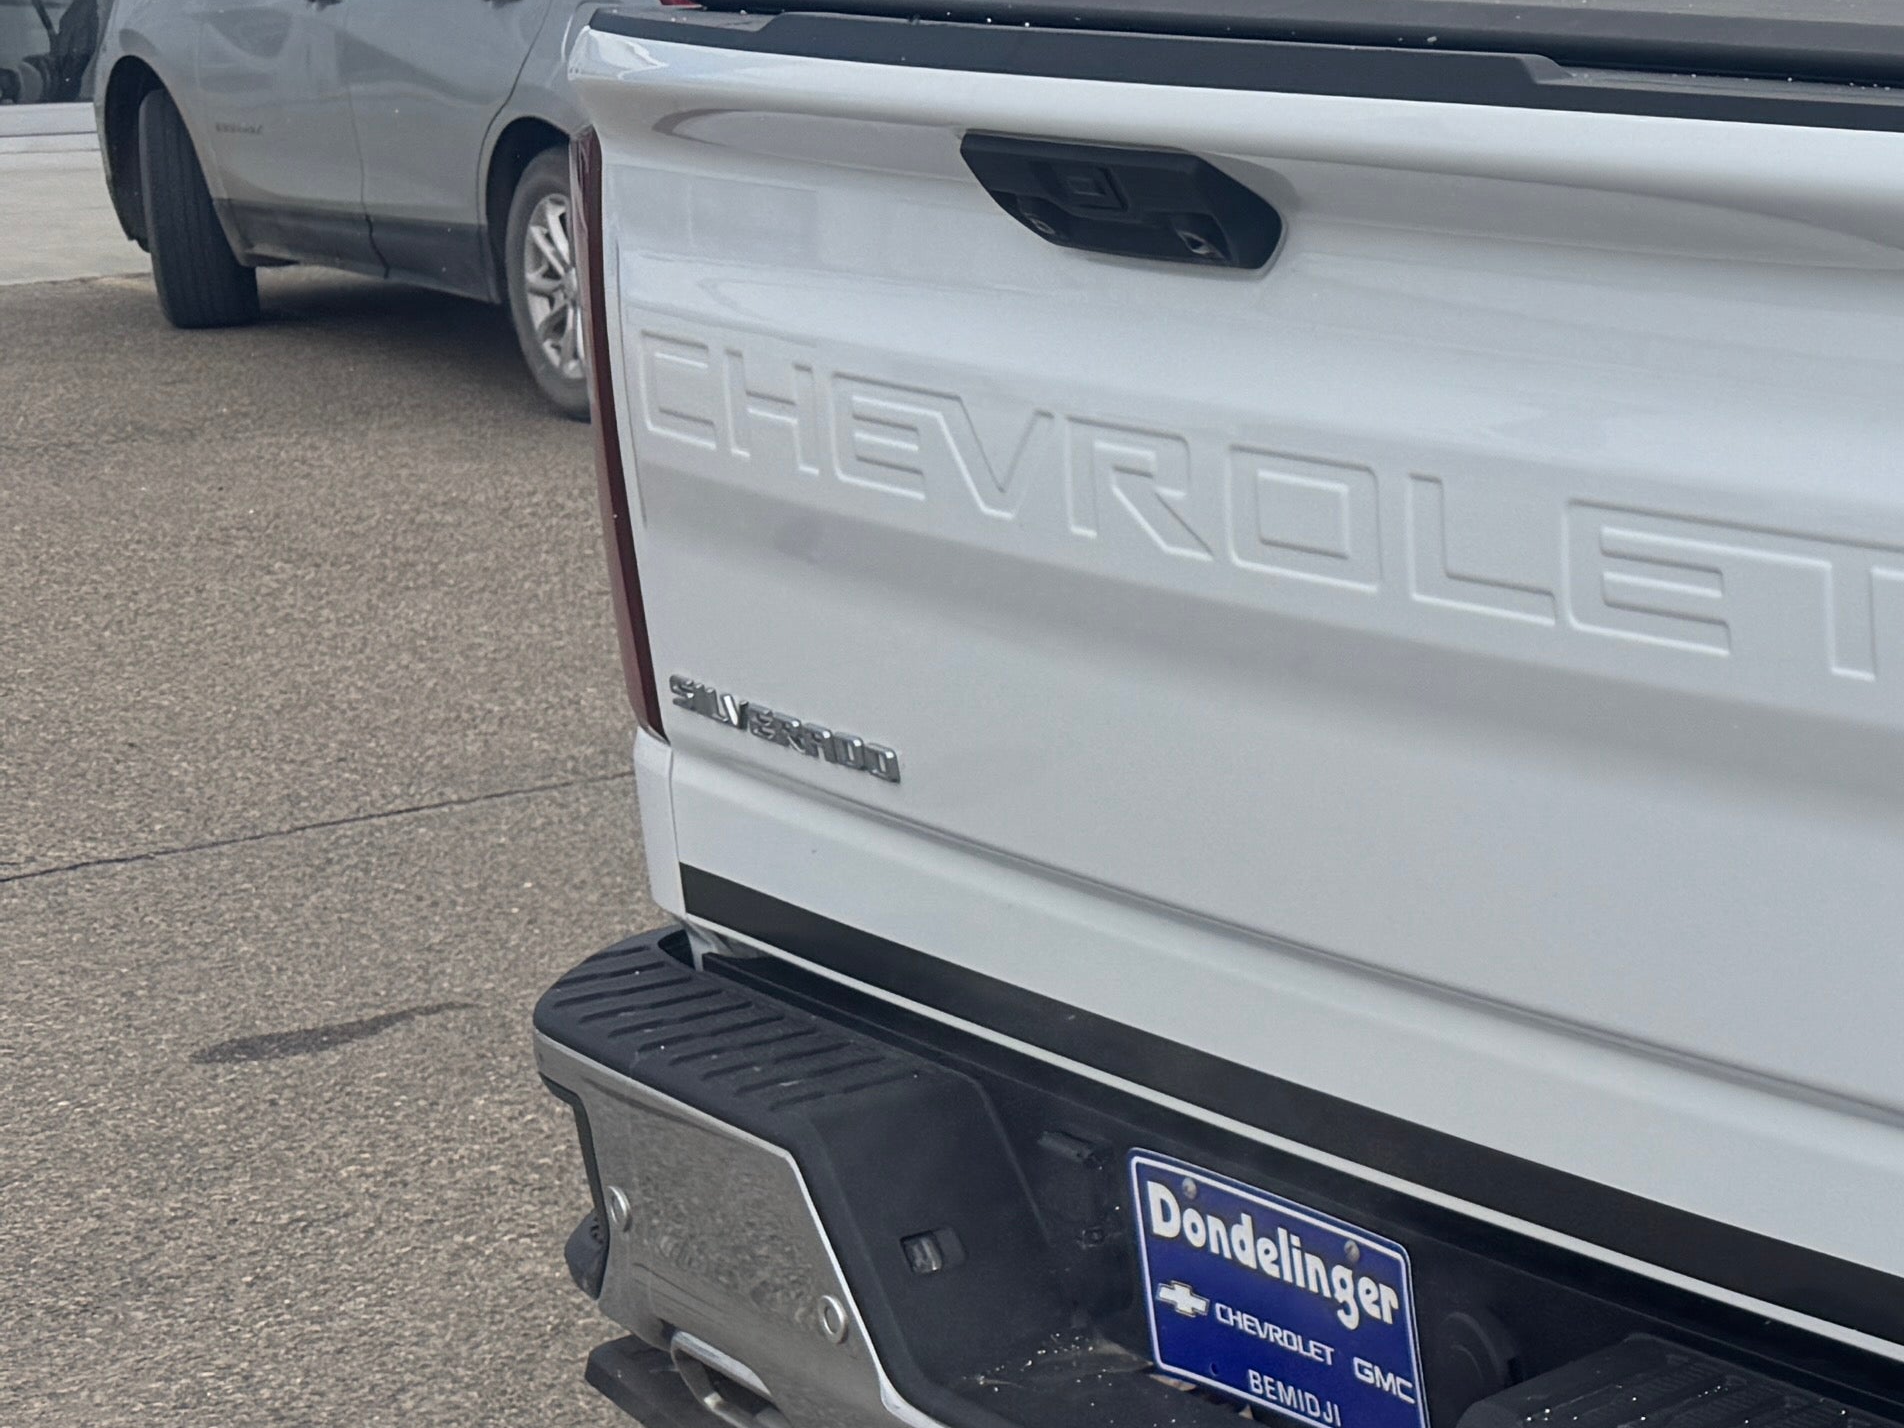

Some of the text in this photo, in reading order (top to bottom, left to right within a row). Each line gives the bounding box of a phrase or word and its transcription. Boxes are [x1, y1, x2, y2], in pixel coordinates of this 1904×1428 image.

[668, 673, 902, 784] SILVERADO
[1146, 1180, 1400, 1331] Dondelinger
[1214, 1302, 1416, 1405] CHEVROLET GMC
[1247, 1368, 1343, 1428] BEMIDJI
